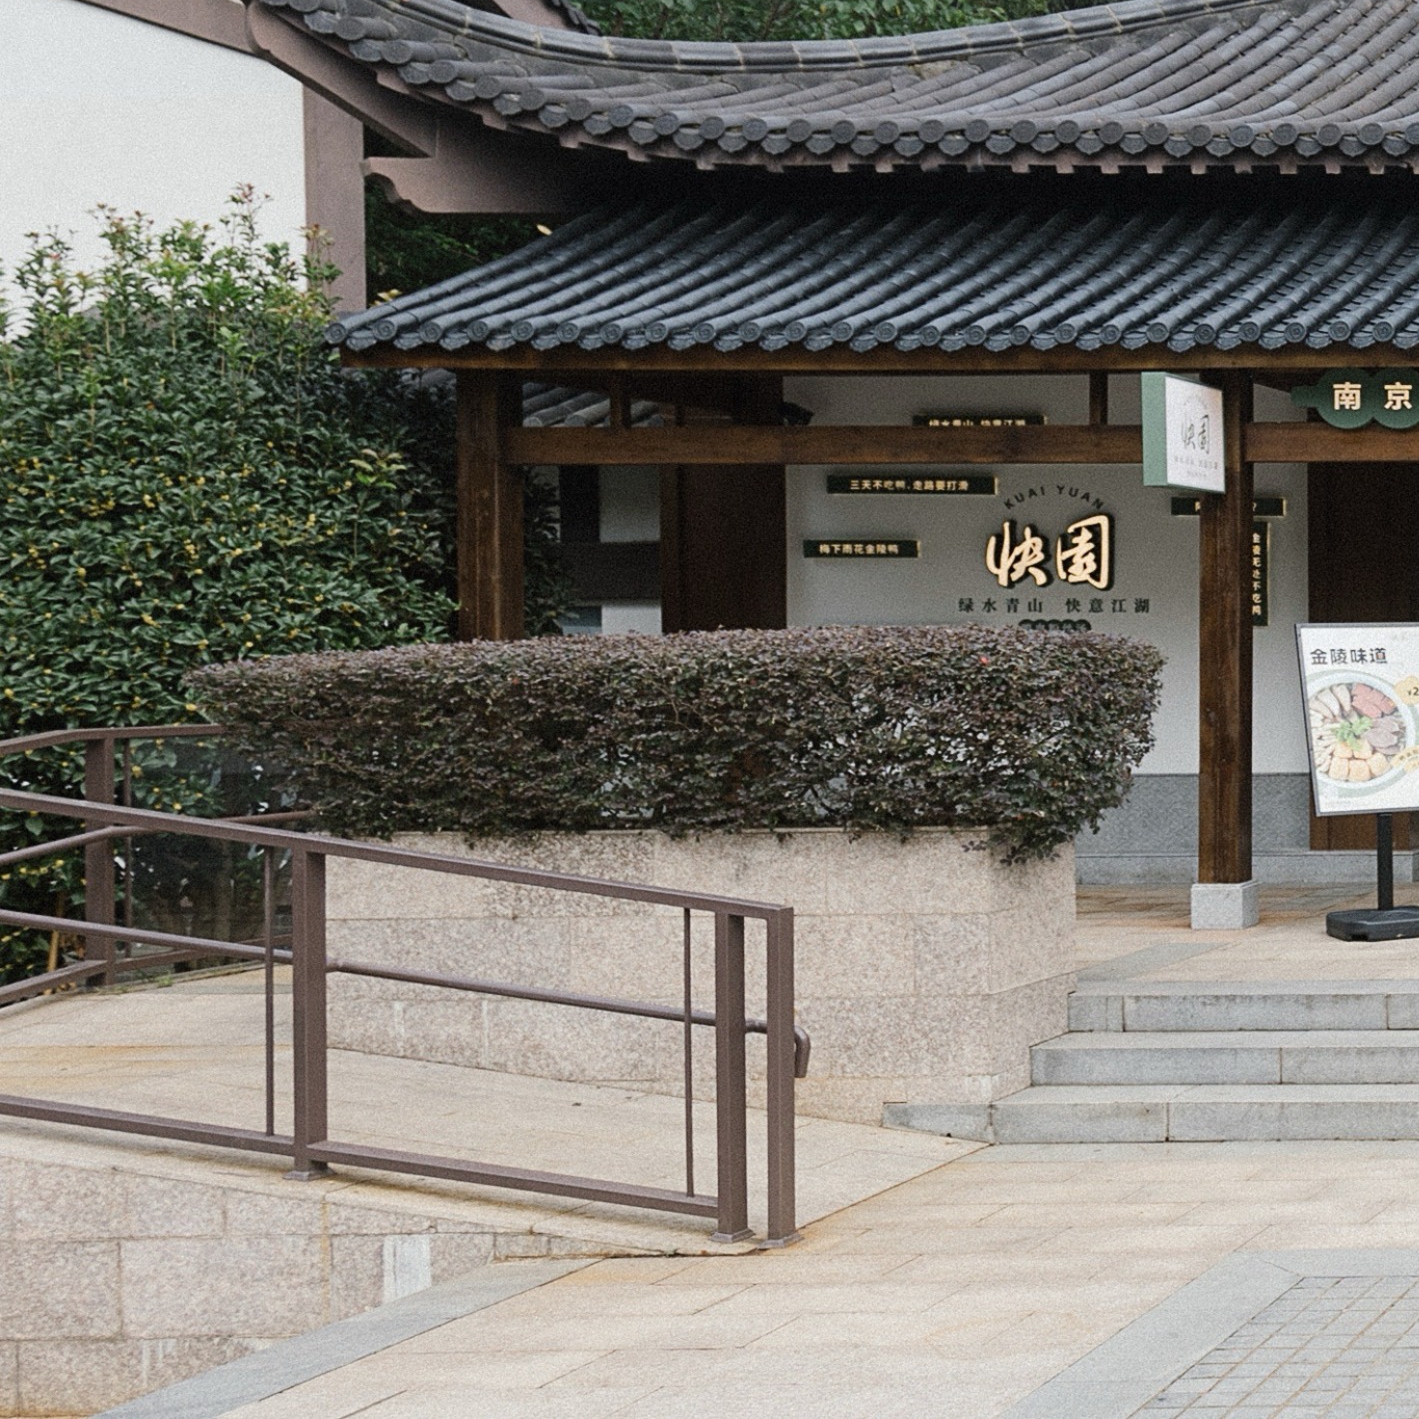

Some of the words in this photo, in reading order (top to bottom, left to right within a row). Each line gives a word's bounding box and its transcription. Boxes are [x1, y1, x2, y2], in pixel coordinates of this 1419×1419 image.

[1003, 486, 1046, 510] KUAI
[1056, 484, 1105, 510] YUAN
[958, 597, 1044, 614] 绿水青山
[1065, 597, 1151, 614] 快意江湖
[1310, 647, 1388, 665] 金陵味道
